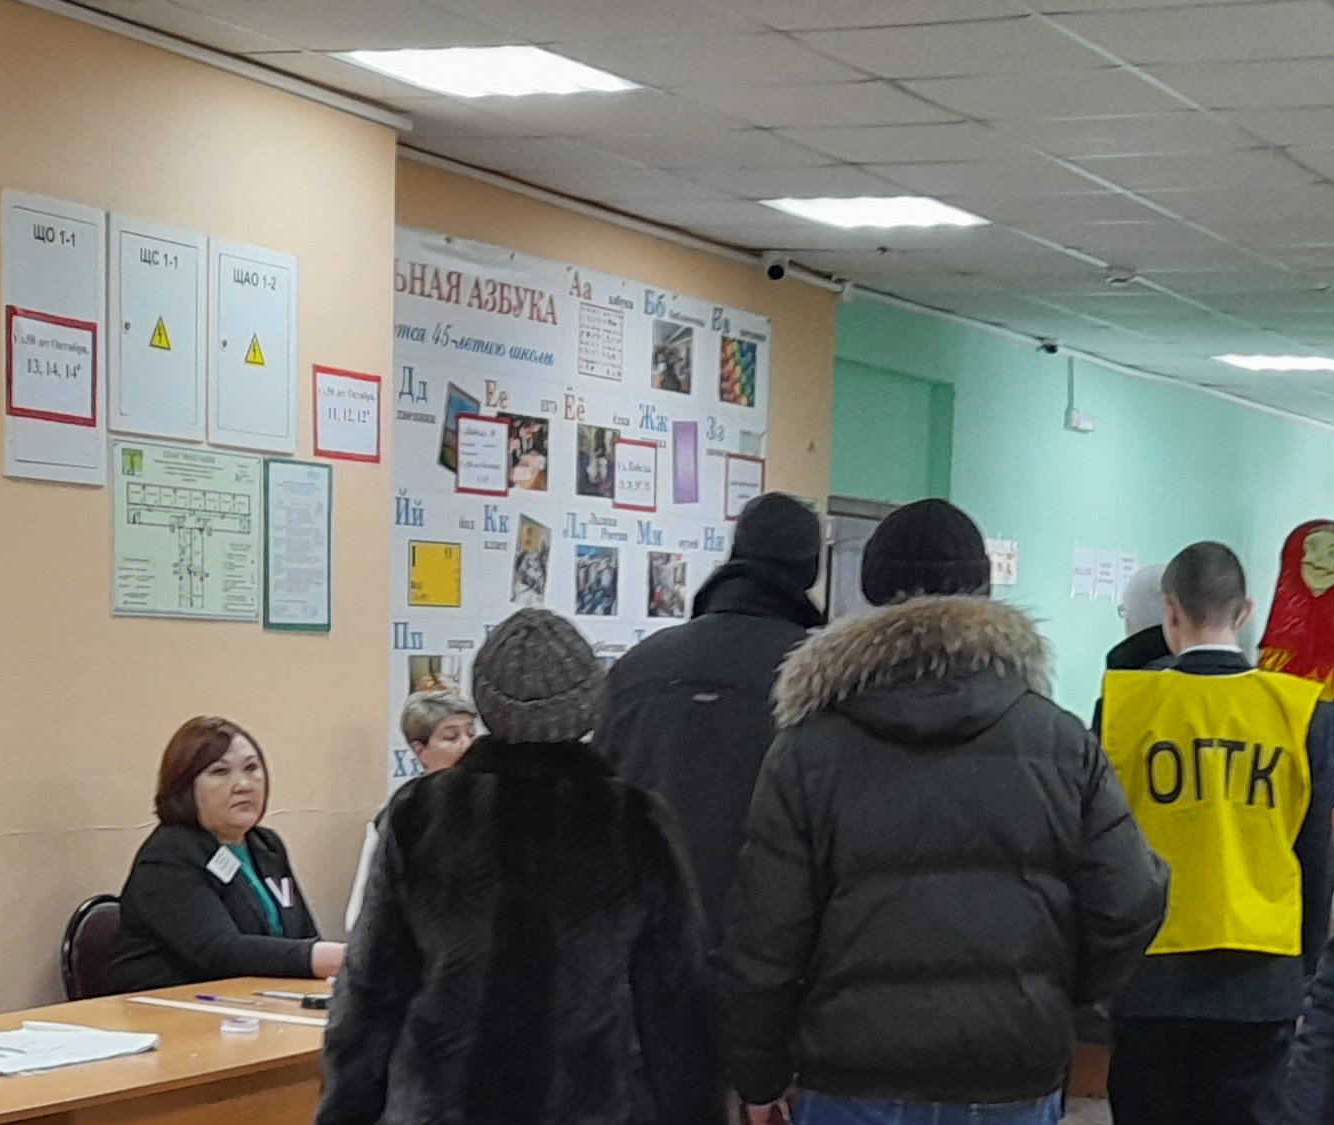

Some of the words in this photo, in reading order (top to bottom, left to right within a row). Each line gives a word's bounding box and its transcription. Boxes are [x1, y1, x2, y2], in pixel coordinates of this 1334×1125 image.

[33, 224, 55, 244] ЩО
[59, 230, 76, 247] 1-1
[140, 247, 159, 265] ЩС
[163, 252, 179, 269] 1-1
[233, 268, 259, 287] ЩАО
[263, 276, 277, 290] 1-2
[569, 270, 593, 300] Аа
[467, 275, 557, 326] АЗБУКА
[643, 290, 666, 318] Бб
[395, 323, 426, 343] тся
[432, 322, 505, 357] 45-летию
[509, 345, 555, 366] школы
[399, 366, 427, 404] Дд
[484, 379, 509, 409] Ее
[563, 386, 585, 421] Ёё
[639, 404, 669, 432] Жж
[394, 488, 424, 526] Йй
[483, 504, 509, 534] Кк
[393, 622, 423, 649] Пп
